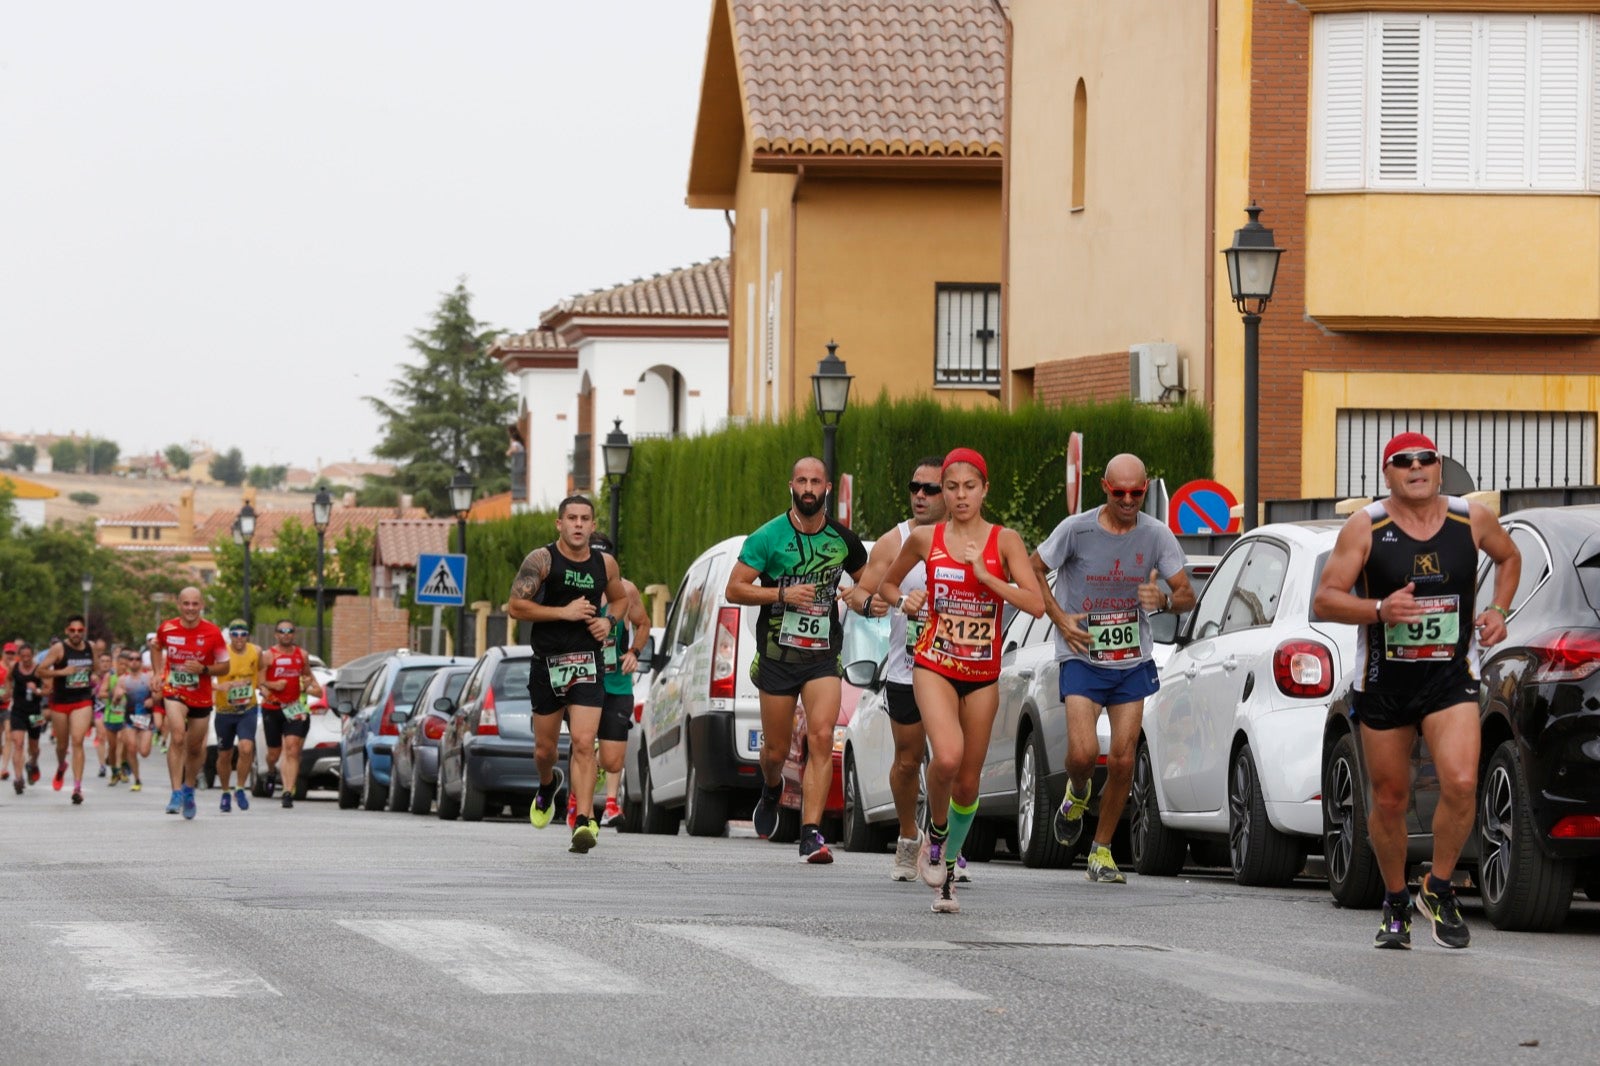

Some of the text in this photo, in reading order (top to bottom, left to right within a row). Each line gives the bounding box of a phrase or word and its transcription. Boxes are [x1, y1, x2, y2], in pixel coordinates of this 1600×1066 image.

[565, 569, 594, 584] FILA
[797, 616, 820, 635] 56
[943, 617, 992, 641] 2122
[1407, 617, 1442, 641] 95
[1098, 626, 1133, 646] 496
[174, 673, 194, 683] 603
[232, 686, 250, 697] 122
